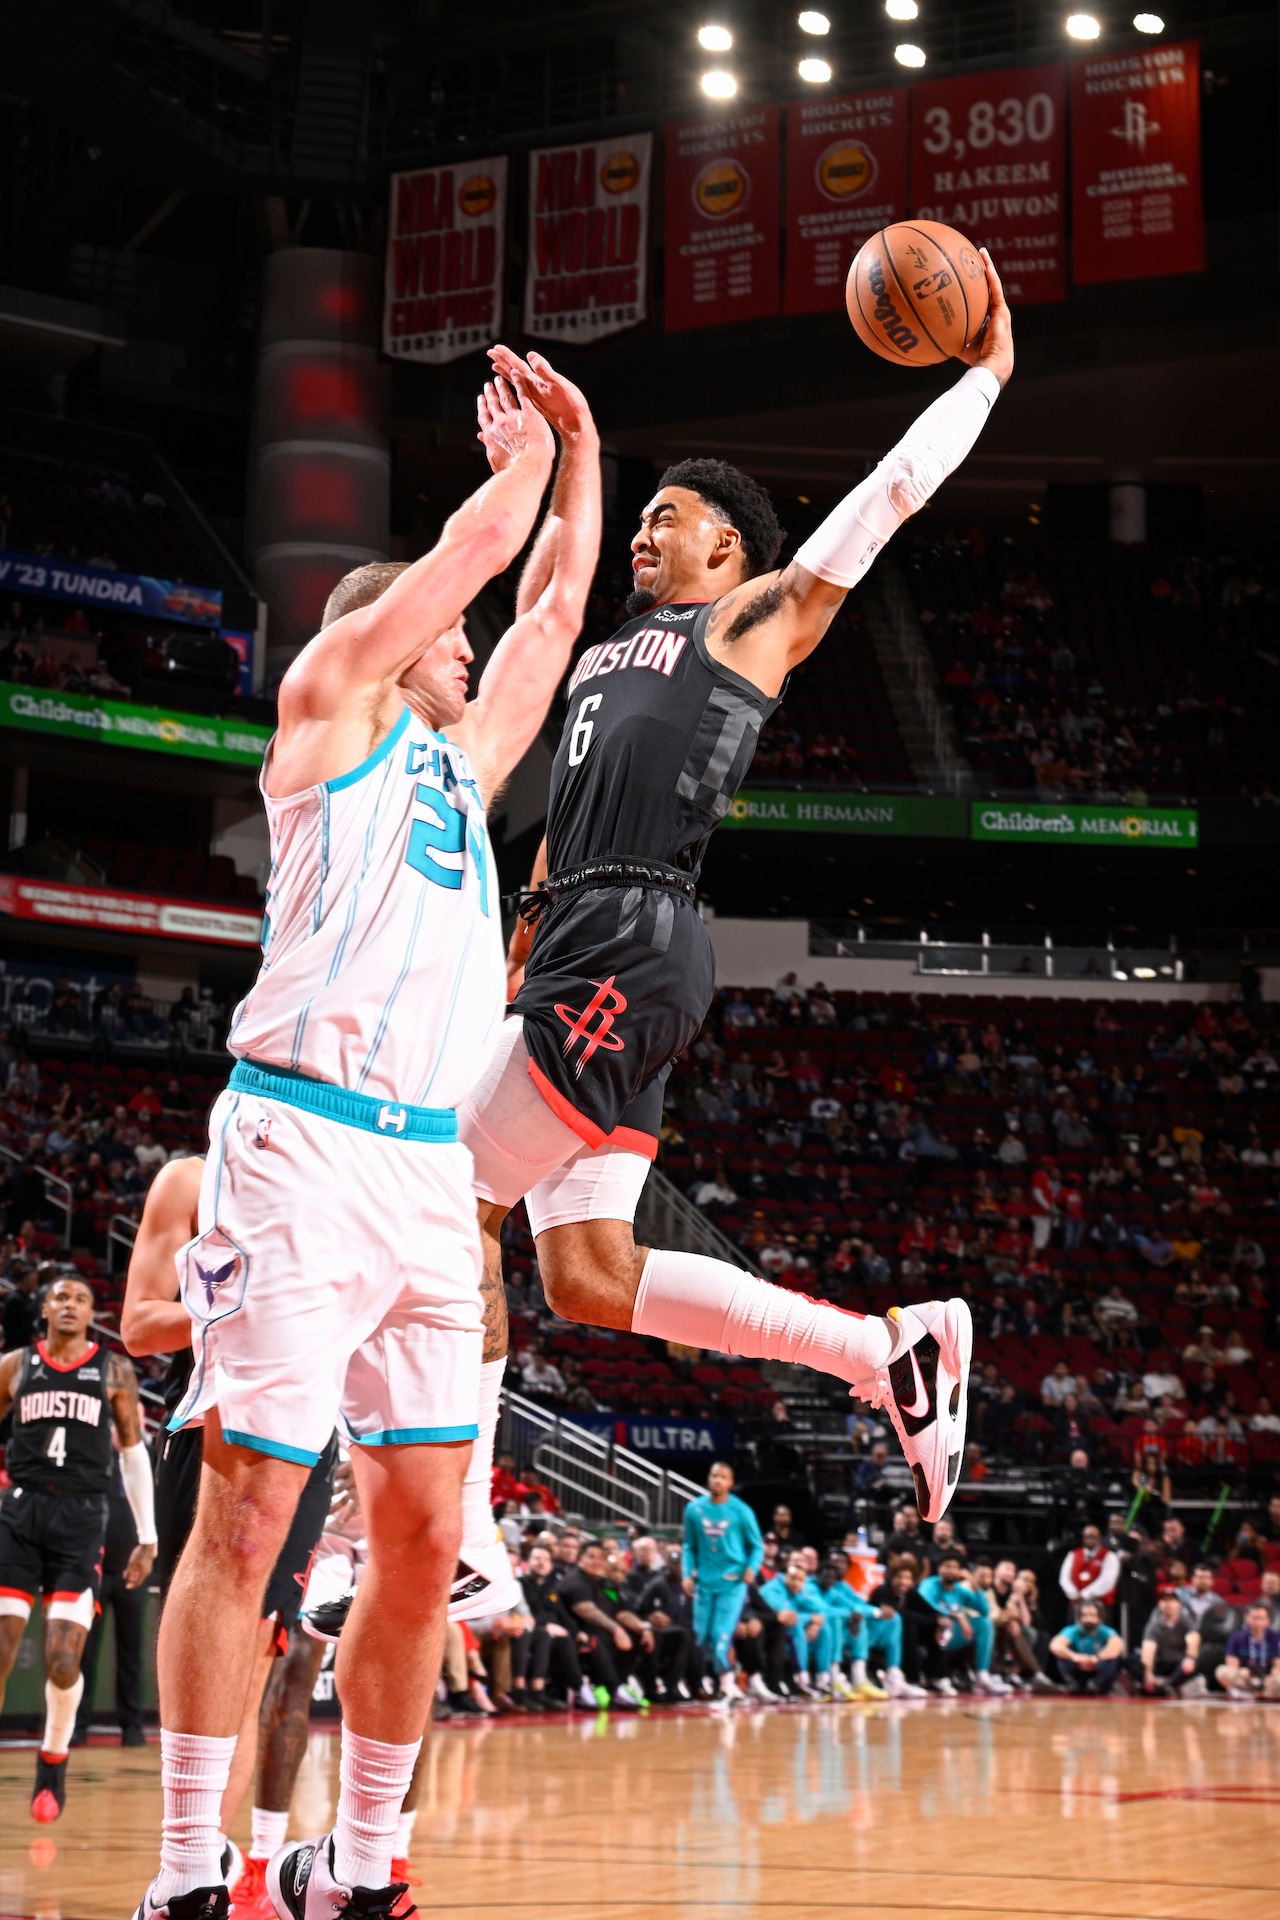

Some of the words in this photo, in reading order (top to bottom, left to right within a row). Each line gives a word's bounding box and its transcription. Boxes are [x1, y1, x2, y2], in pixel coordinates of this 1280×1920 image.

[1085, 48, 1185, 78] HOUSTON
[1085, 66, 1185, 95] ROCKETS
[801, 95, 895, 120] HOUSTON
[801, 112, 894, 137] ROCKETS
[924, 92, 1055, 160] 3,830
[537, 147, 596, 213] NBA
[934, 160, 1051, 193] HAKEEM
[1099, 160, 1175, 184] DIVISION
[916, 192, 1059, 228] OLAJUWON
[535, 203, 639, 277] WORLD
[393, 225, 495, 300] WORLD
[50, 568, 144, 607] TUNDRA
[568, 693, 604, 767] 6
[797, 804, 894, 823] HERMANN
[981, 810, 1077, 835] Children's
[1081, 816, 1184, 839] MEMORIAL
[20, 1390, 102, 1428] HOUSTON
[47, 1426, 67, 1468] 4
[632, 1425, 716, 1452] ULTRA
